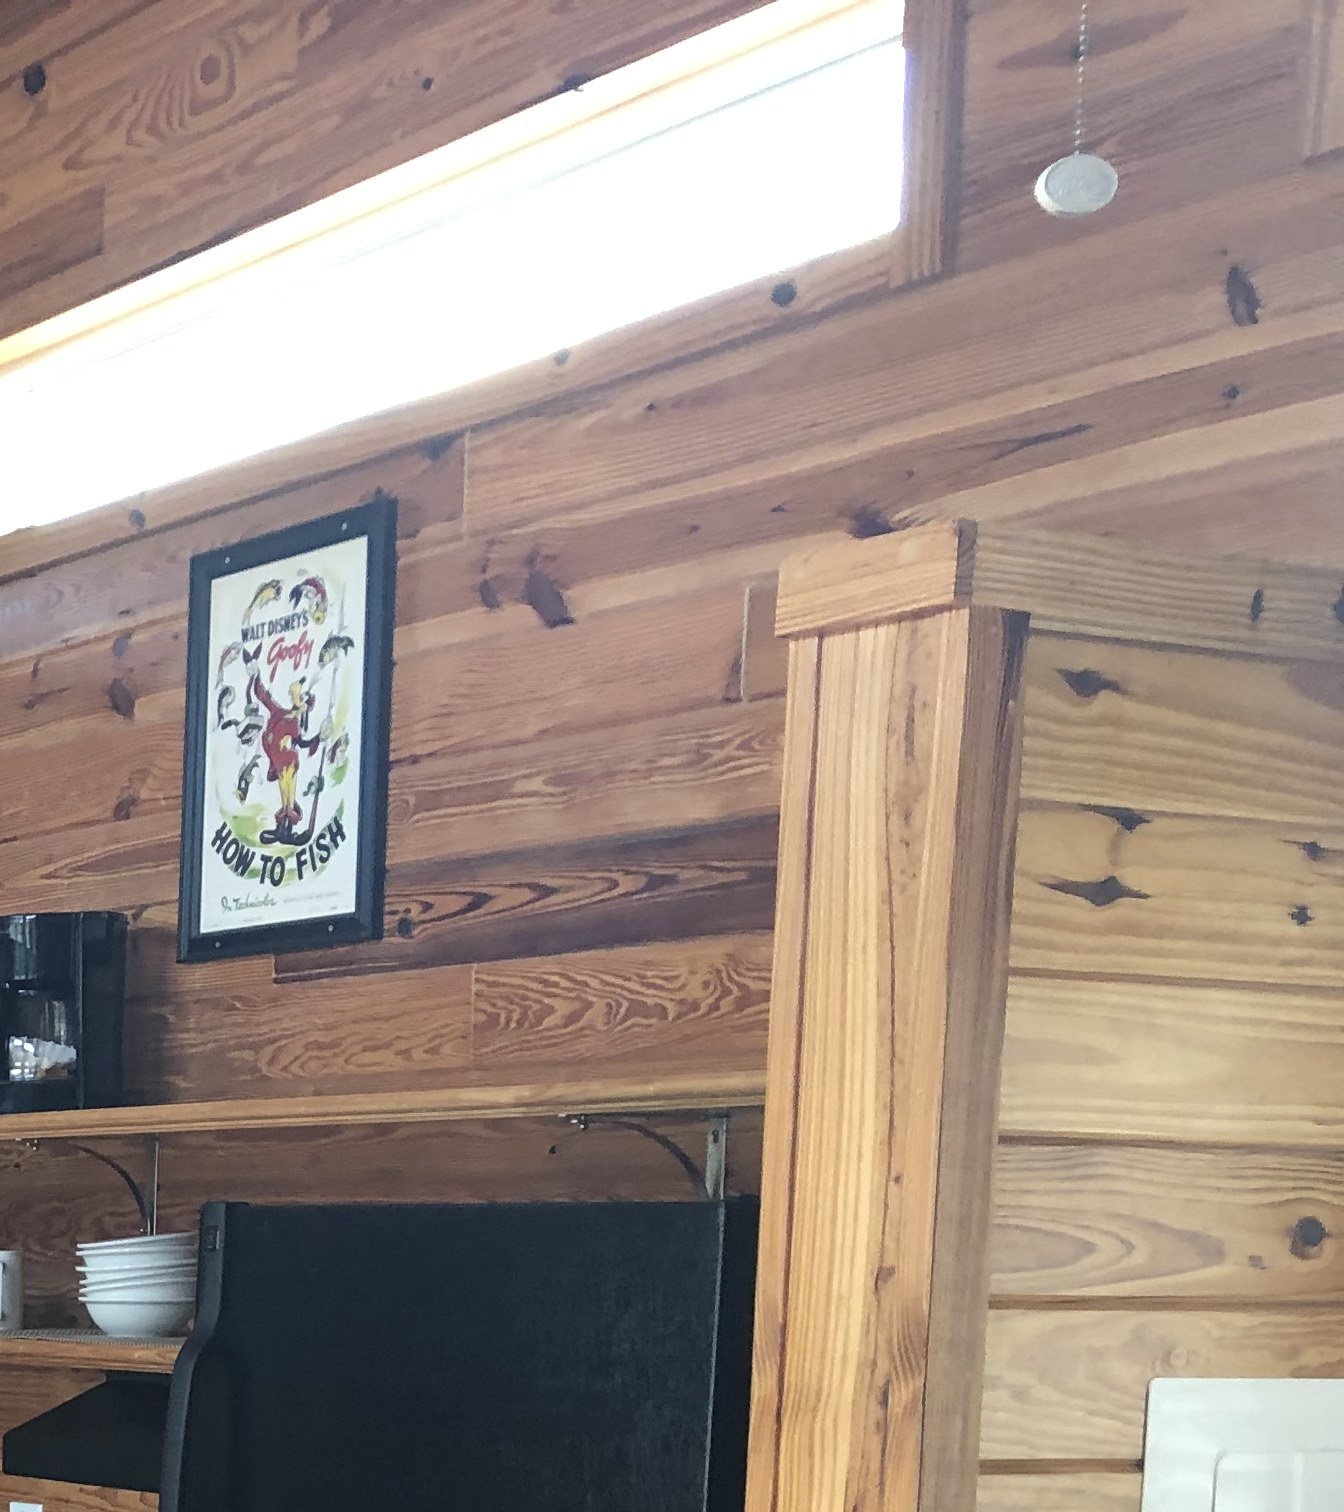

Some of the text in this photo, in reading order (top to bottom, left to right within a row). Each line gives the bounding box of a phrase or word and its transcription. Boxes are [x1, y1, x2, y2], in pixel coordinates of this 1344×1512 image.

[241, 608, 309, 643] WALT DISNEY'S
[267, 630, 314, 683] Goofy
[211, 816, 346, 886] HOW TO FISH
